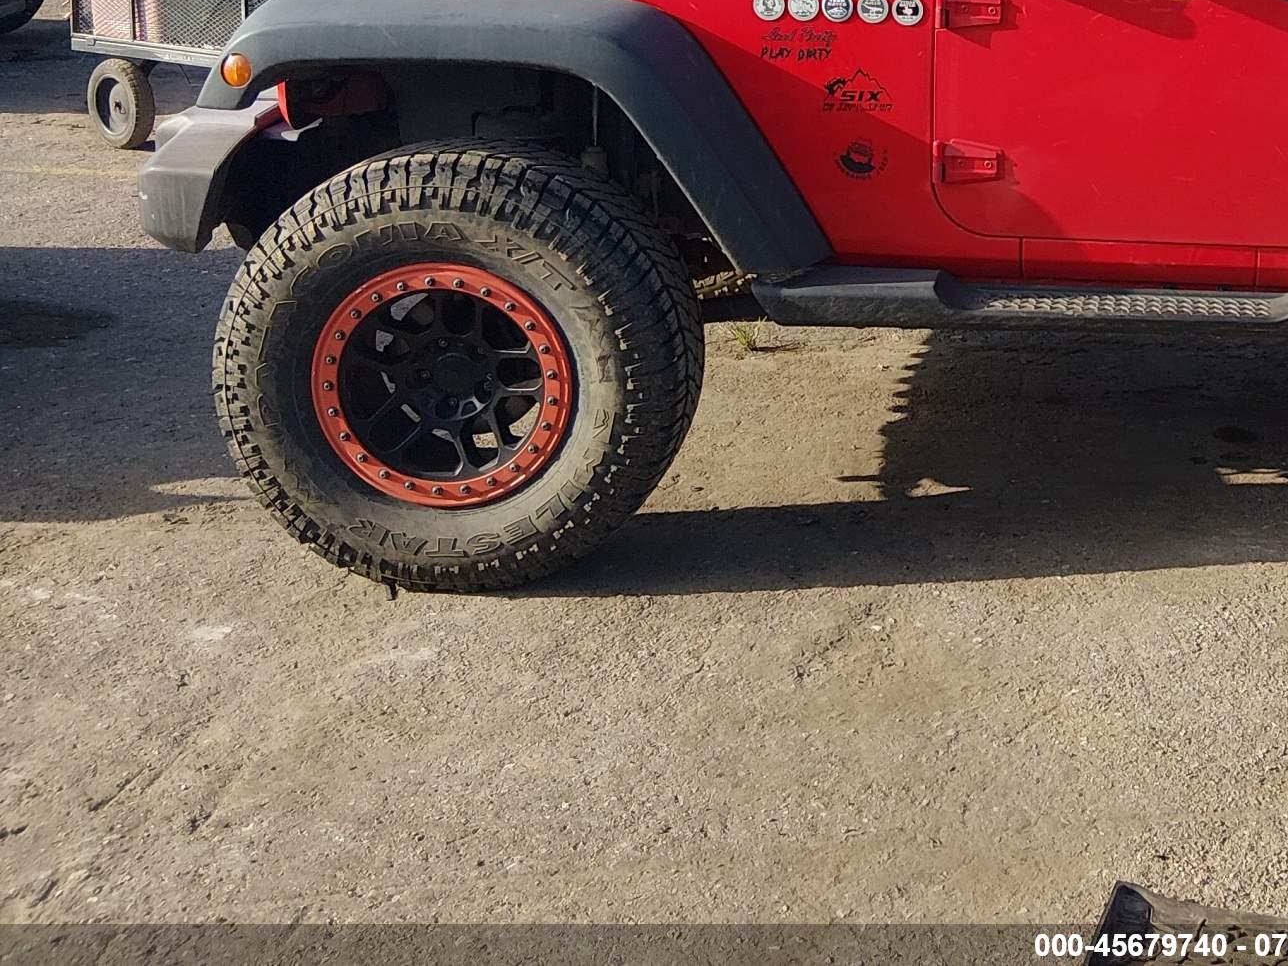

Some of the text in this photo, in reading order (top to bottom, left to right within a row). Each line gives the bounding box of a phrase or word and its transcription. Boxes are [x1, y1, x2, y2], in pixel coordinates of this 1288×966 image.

[760, 46, 832, 62] PLAY DIRTY
[840, 90, 882, 102] SIX
[346, 445, 607, 559] MILESTAR
